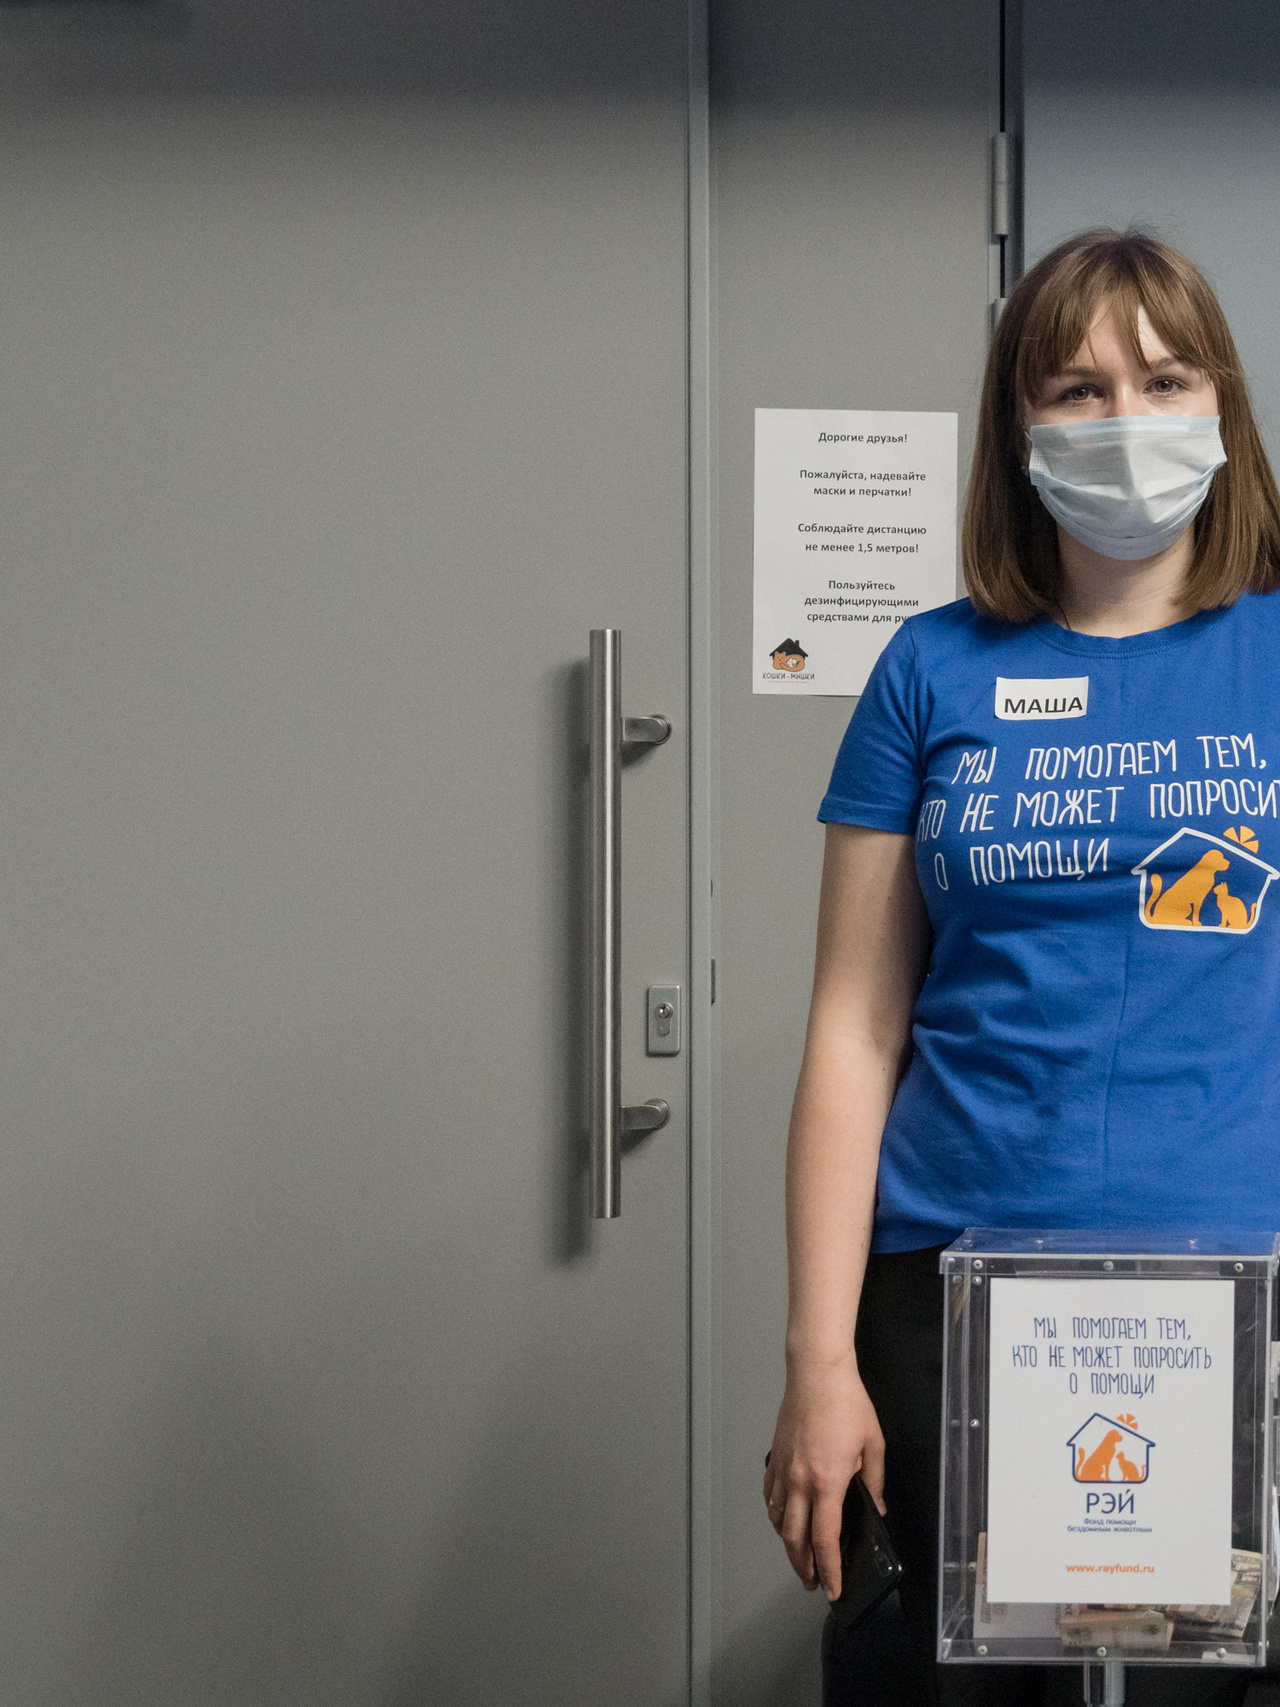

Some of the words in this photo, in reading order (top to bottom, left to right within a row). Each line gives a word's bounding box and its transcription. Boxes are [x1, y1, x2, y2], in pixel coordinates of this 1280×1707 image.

[818, 432, 863, 443] Дорогие
[866, 433, 907, 444] друзья!
[800, 469, 866, 481] Пожалуйста,
[870, 471, 926, 482] надевайте
[858, 487, 911, 497] перчатки!
[797, 523, 864, 534] Соблюдайте
[866, 526, 926, 535] дистанцию
[858, 543, 872, 553] 1,5
[876, 543, 918, 554] метров!
[828, 580, 895, 591] Пользуйтесь
[804, 596, 918, 608] дезинфицирующими
[806, 613, 868, 623] средствами
[871, 615, 891, 623] для
[1004, 695, 1084, 715] МАША
[951, 746, 998, 785] МЫ
[1025, 739, 1178, 781] ПОМОГАЕМ
[1196, 732, 1267, 770] ТЕМ,
[917, 799, 947, 842] КТО
[960, 792, 999, 834] НЕ
[1013, 786, 1125, 828] МОЖЕТ
[934, 852, 949, 891] О
[969, 837, 1110, 886] ПОМОЩИ
[1033, 1317, 1056, 1338] МЫ
[1072, 1316, 1146, 1339] ПОМОГАЕМ
[1156, 1317, 1190, 1340] ТЕМ,
[1012, 1344, 1037, 1367] КТО
[1048, 1345, 1065, 1367] НЕ
[1072, 1345, 1122, 1368] МОЖЕТ
[1133, 1346, 1211, 1369] ПОПРОСИТЬ
[1069, 1372, 1077, 1394] О
[1090, 1372, 1154, 1399] ПОМОЩИ
[1086, 1488, 1134, 1514] РЭЙ
[1065, 1563, 1154, 1574] www.rayfund.ru
